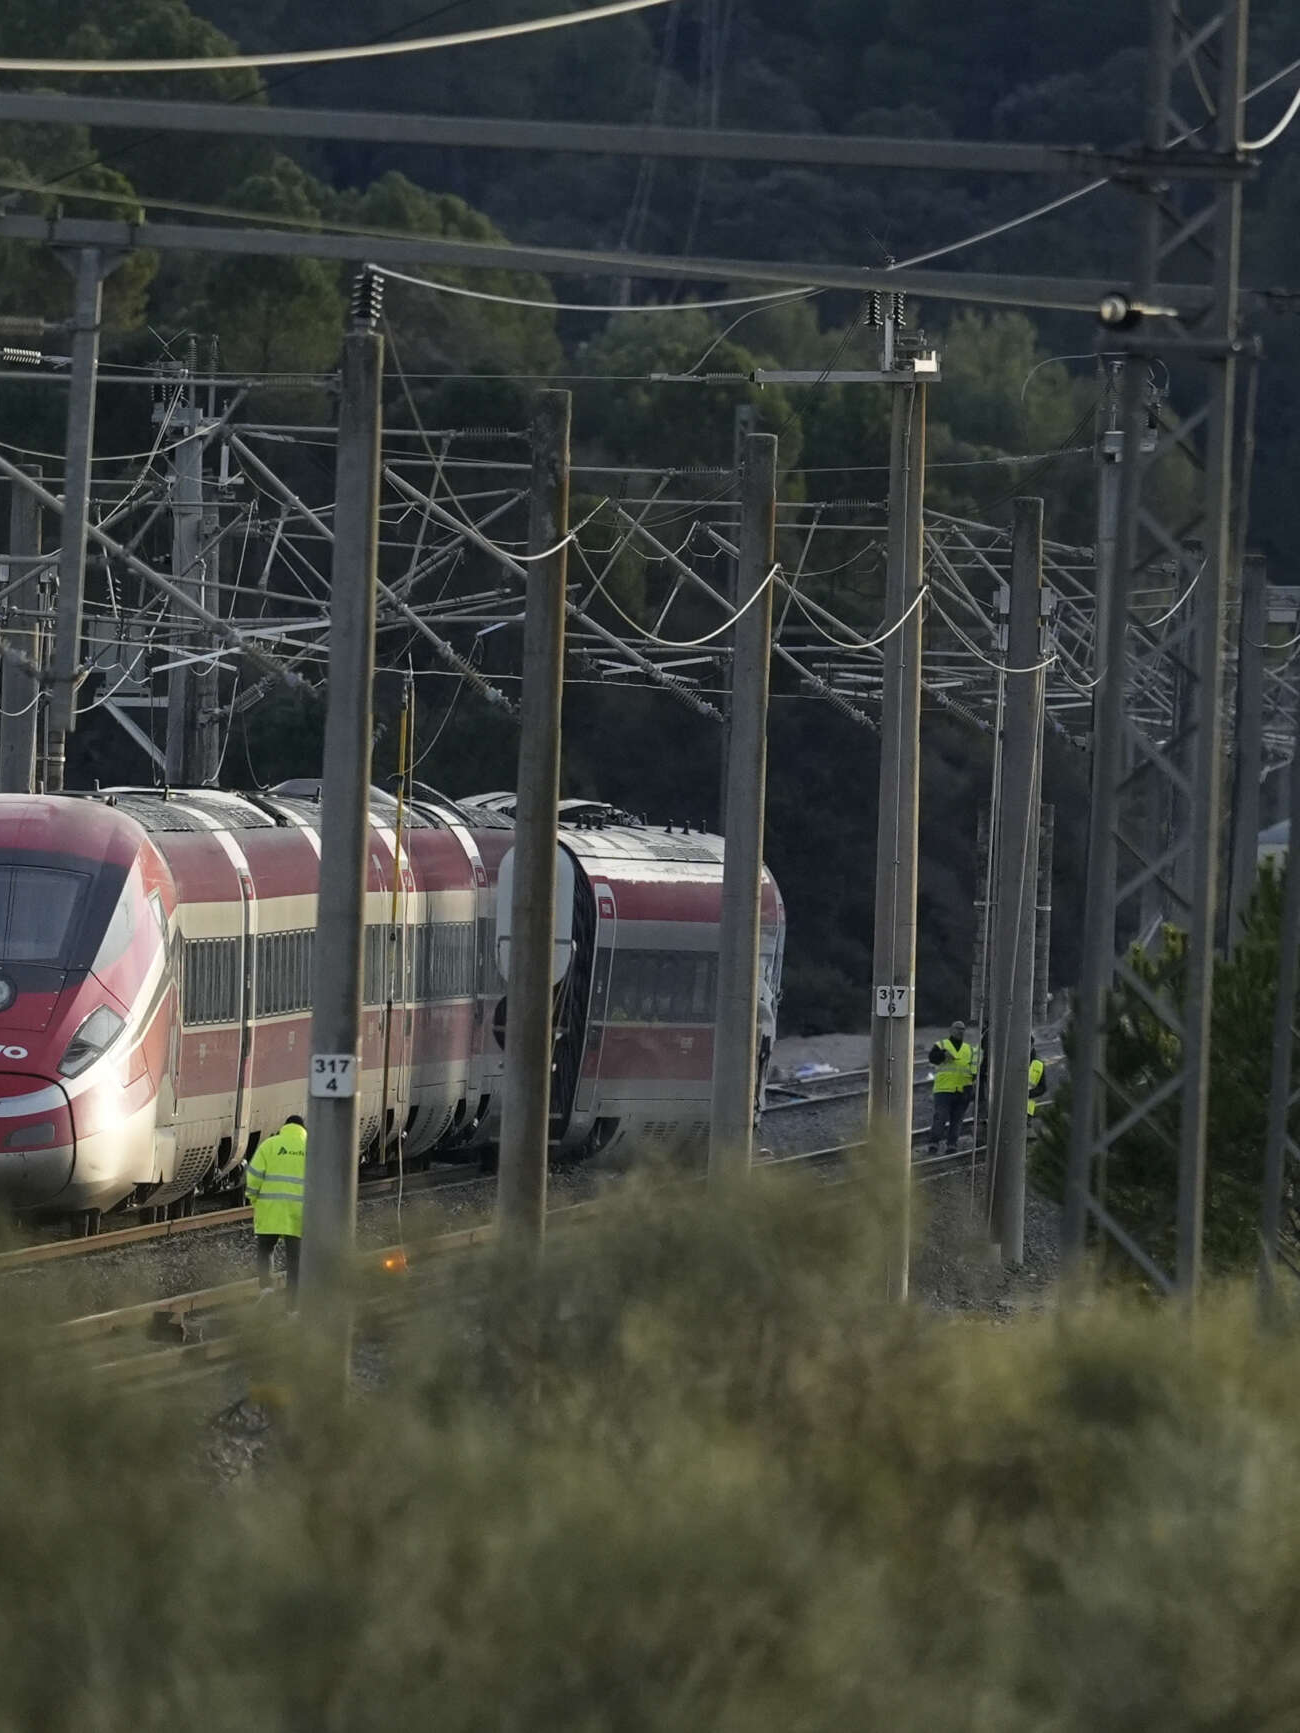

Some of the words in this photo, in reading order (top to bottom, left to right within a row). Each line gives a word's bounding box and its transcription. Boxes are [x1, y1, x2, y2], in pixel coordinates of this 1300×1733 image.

[879, 989, 905, 1000] 317
[315, 1059, 350, 1074] 317
[326, 1077, 338, 1092] 4
